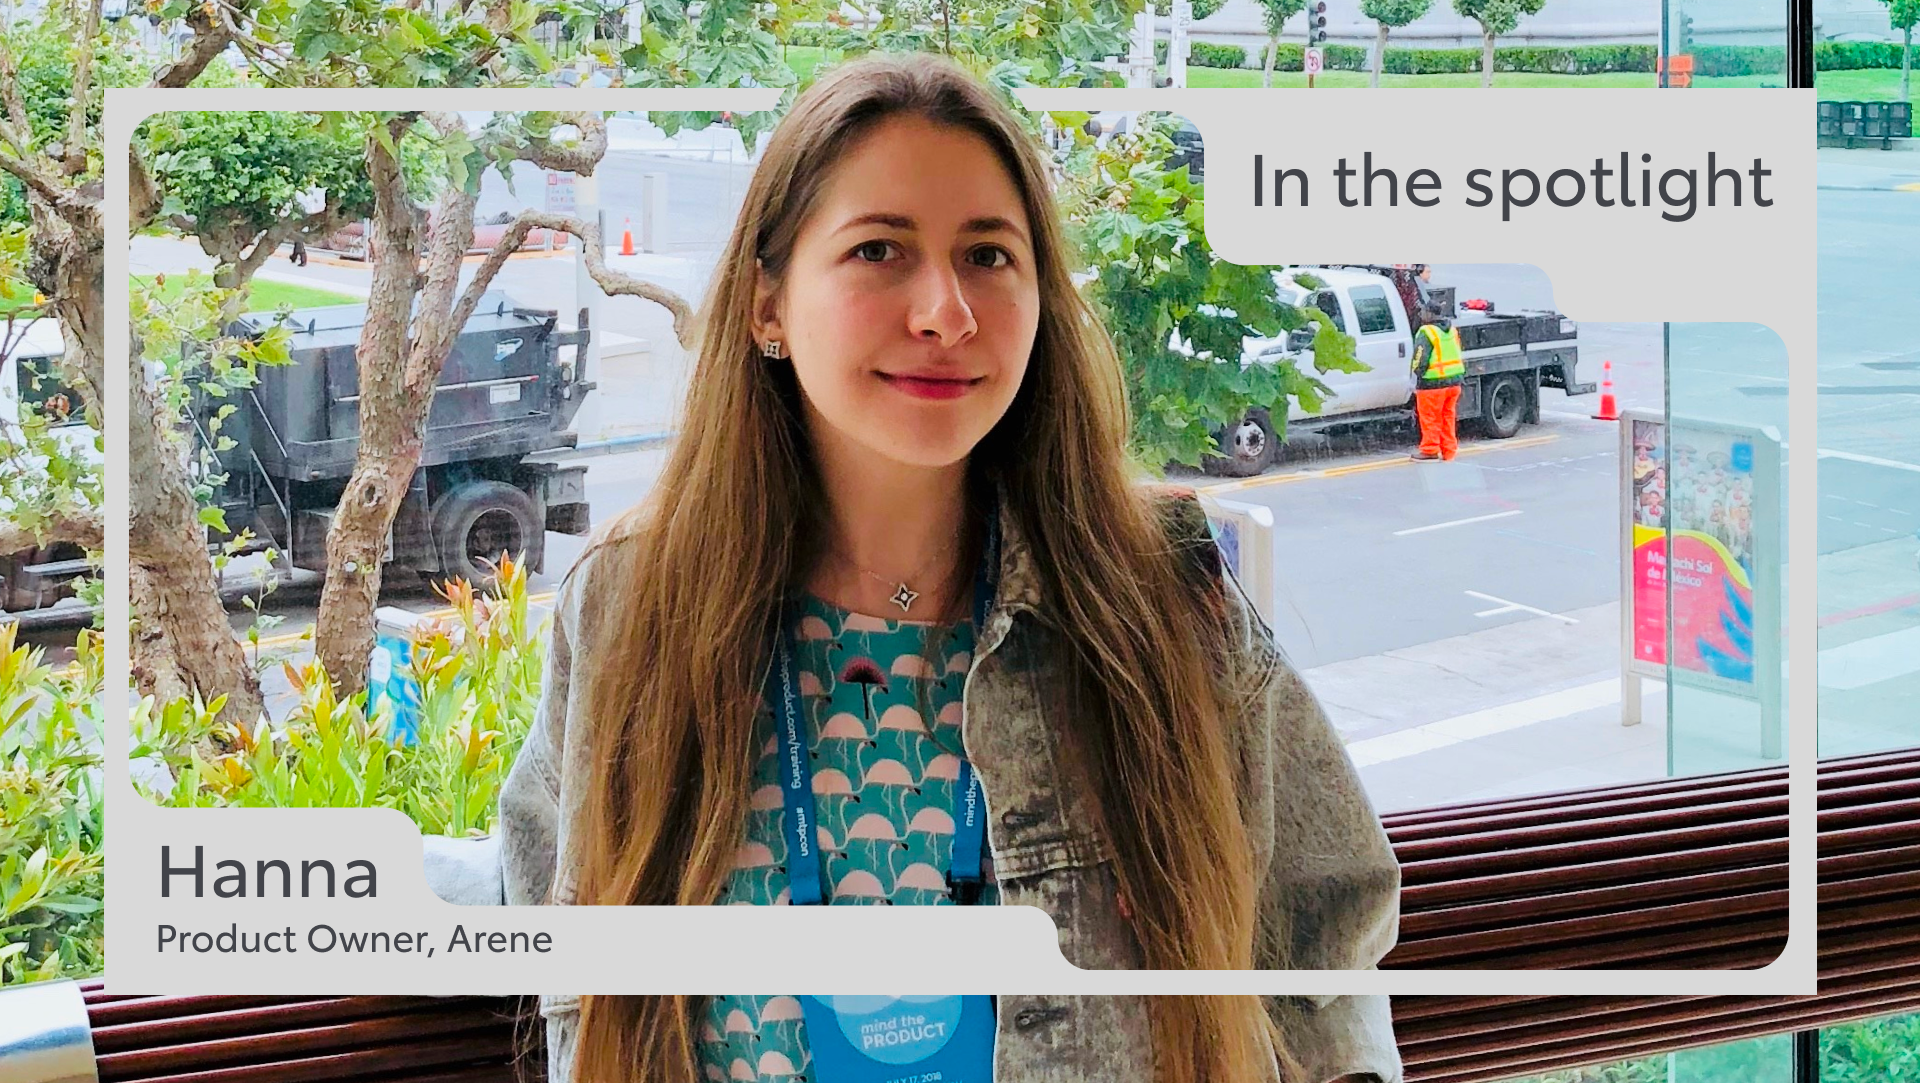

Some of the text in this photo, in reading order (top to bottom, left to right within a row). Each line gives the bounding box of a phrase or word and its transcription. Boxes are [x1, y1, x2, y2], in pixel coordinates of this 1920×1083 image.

[1647, 550, 1713, 574] Maachi Sol
[1647, 566, 1661, 579] de
[779, 654, 809, 857] theproduct.com/training #mtpcon
[861, 1015, 925, 1034] mind the
[862, 1023, 945, 1049] PRODUCT
[922, 1071, 942, 1083] 2018
